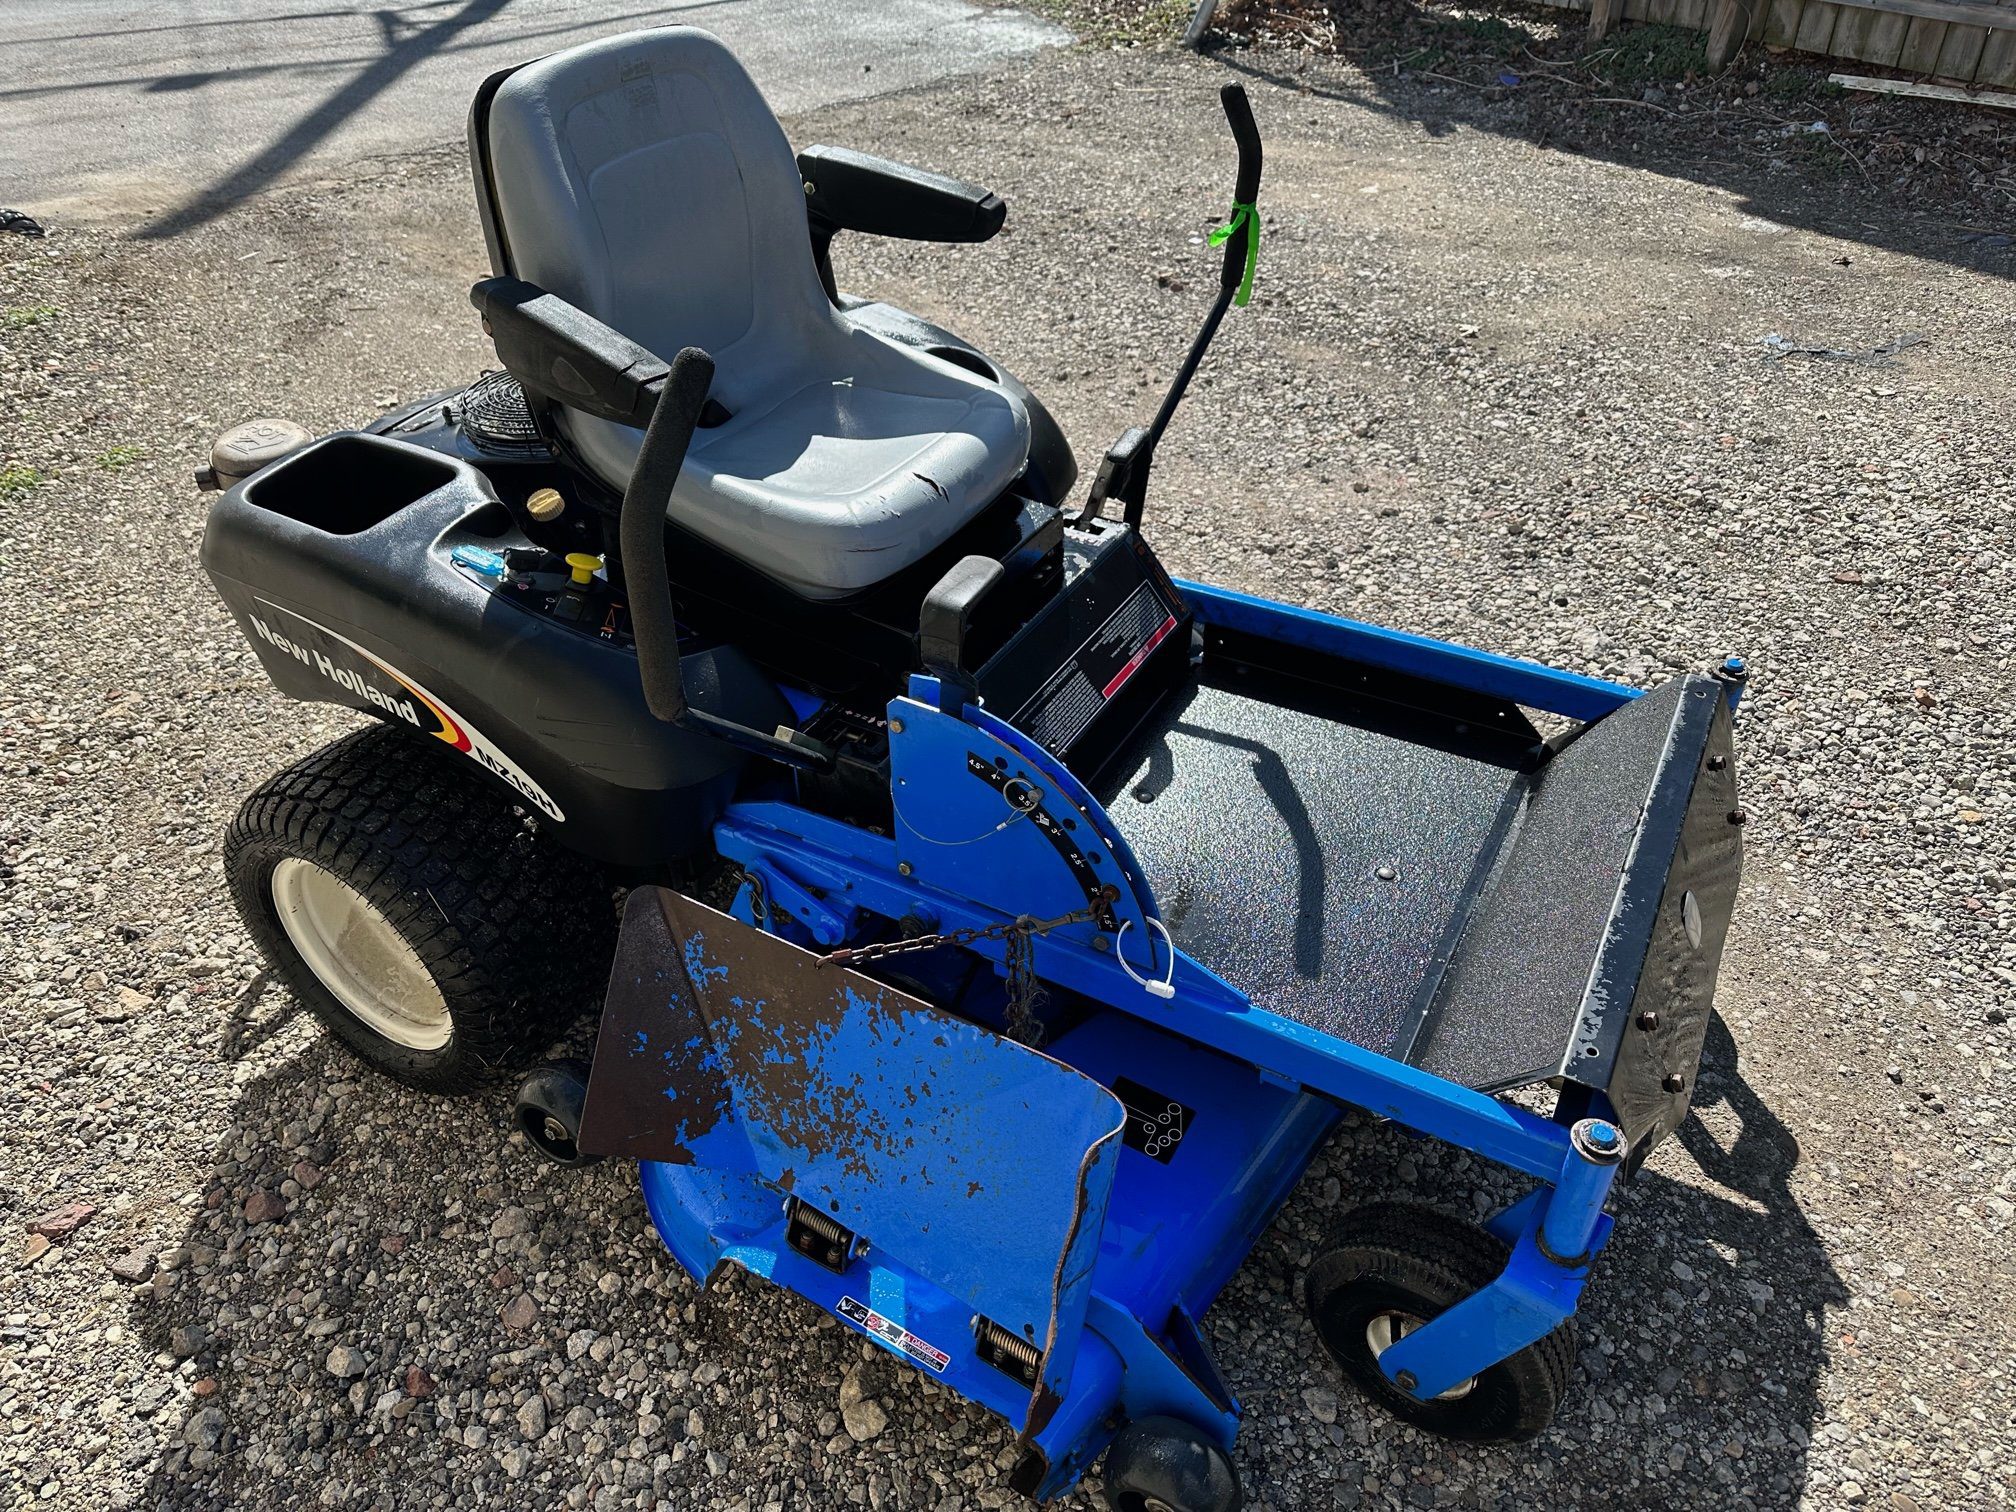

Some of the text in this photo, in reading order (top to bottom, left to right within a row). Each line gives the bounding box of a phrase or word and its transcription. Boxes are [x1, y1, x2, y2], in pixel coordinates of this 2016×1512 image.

[249, 613, 421, 727] New Holland
[968, 758, 985, 770] 4.5"
[474, 744, 558, 817] MZ19H
[1070, 853, 1085, 868] 2.5"
[1103, 914, 1113, 928] 1.5"
[912, 1338, 938, 1357] DANGER
